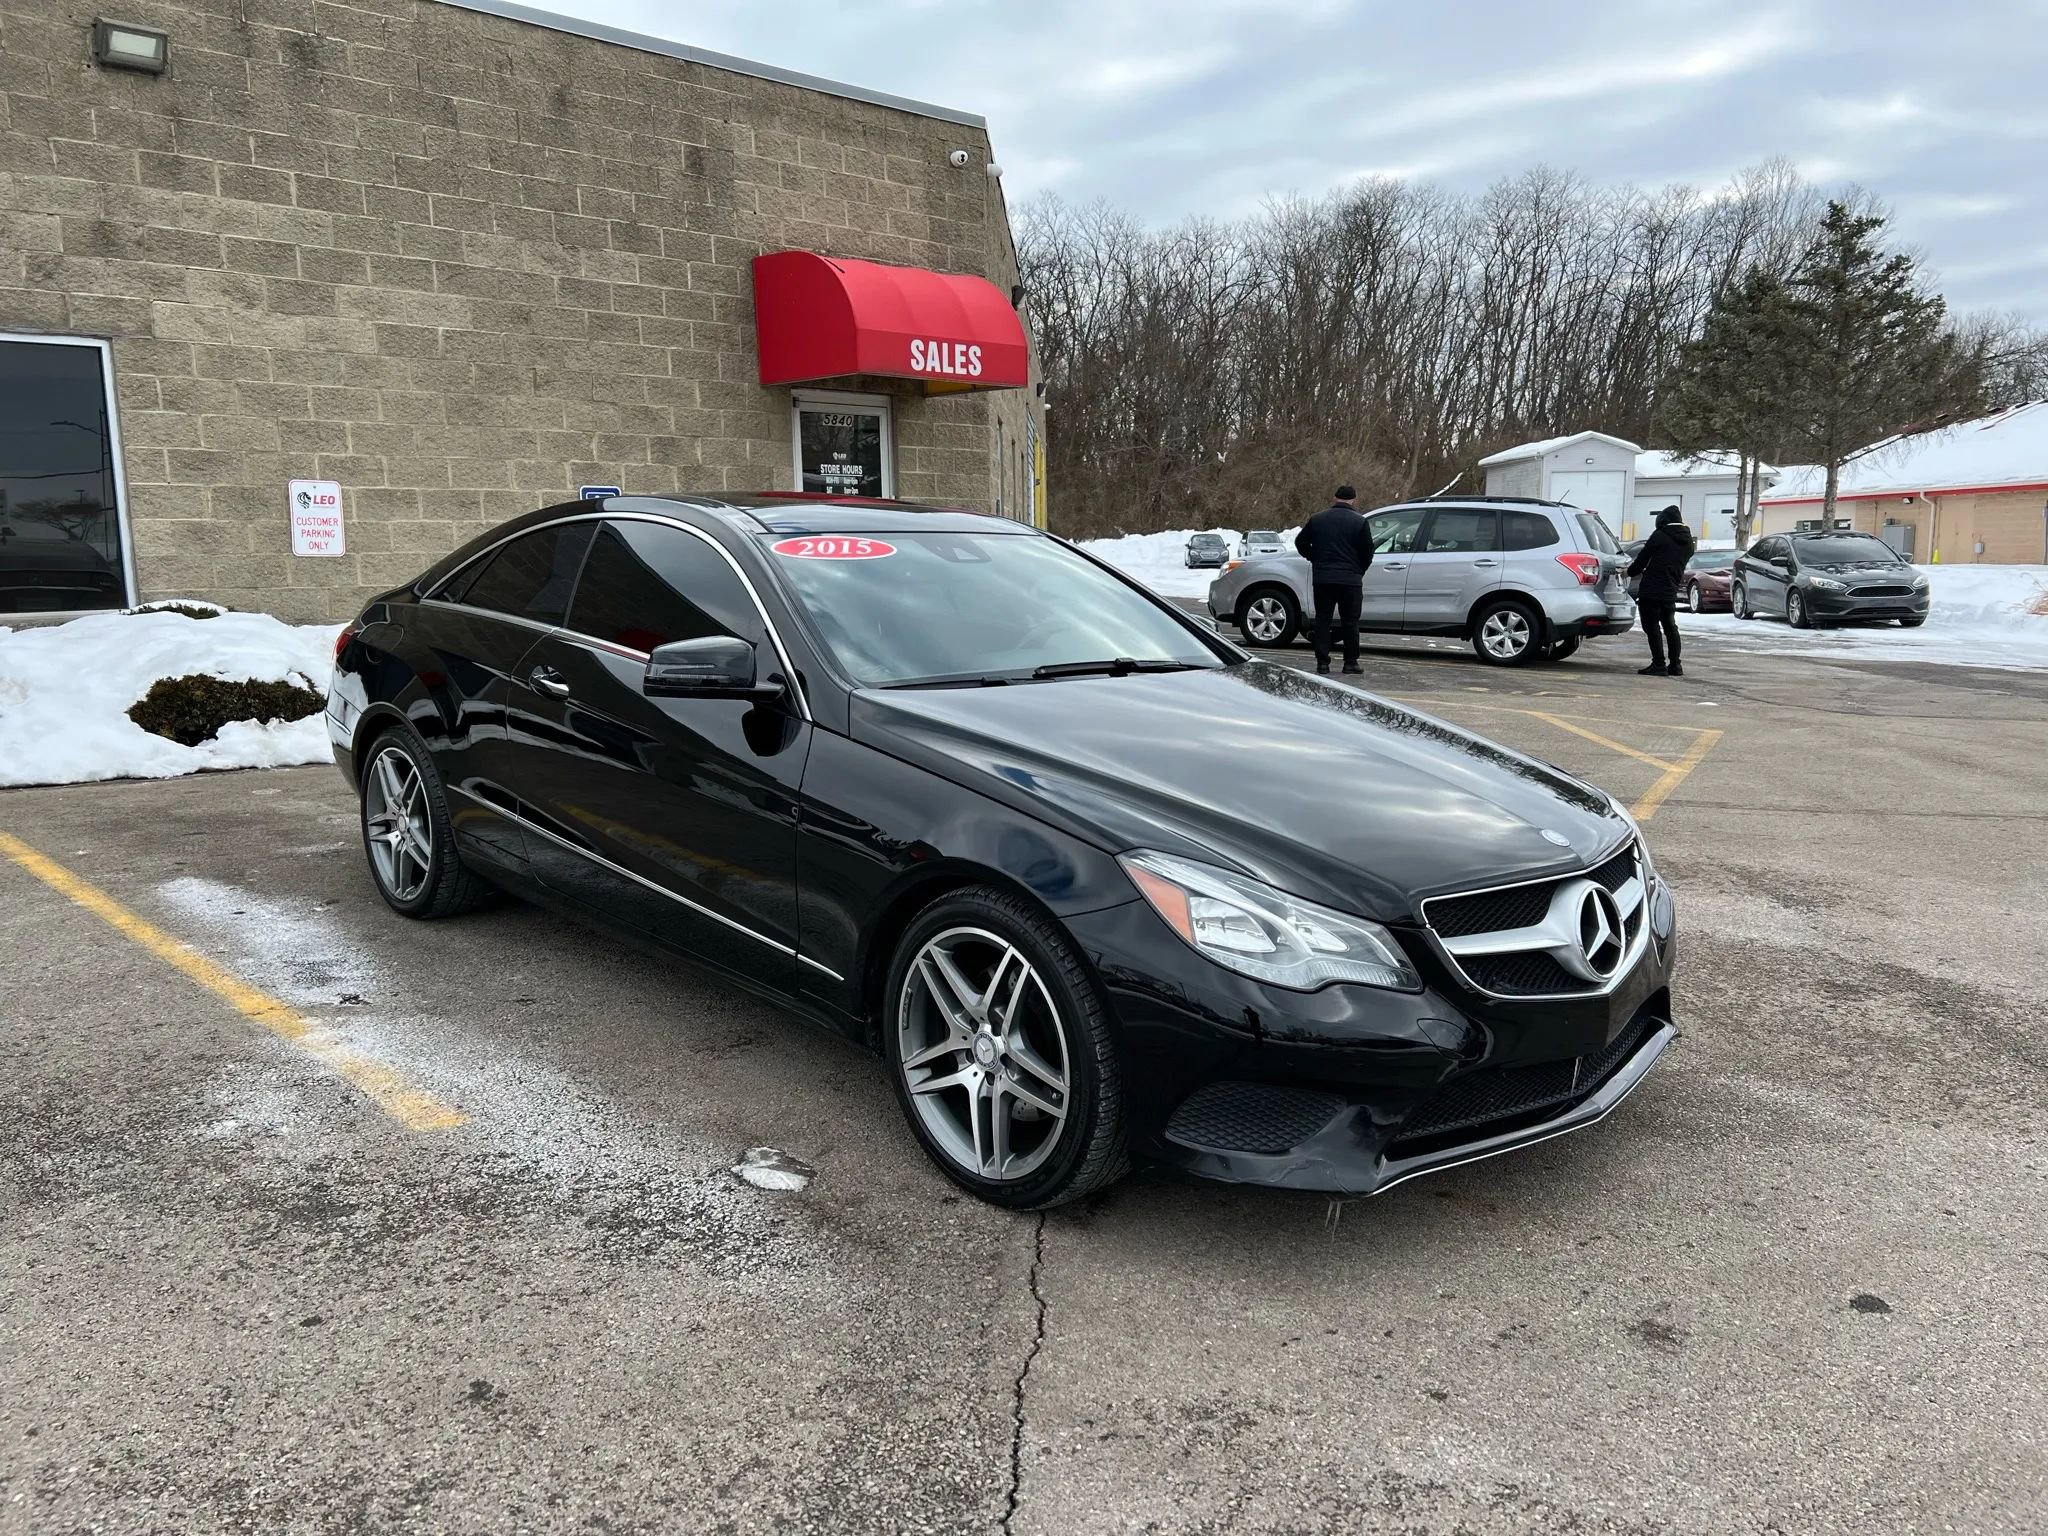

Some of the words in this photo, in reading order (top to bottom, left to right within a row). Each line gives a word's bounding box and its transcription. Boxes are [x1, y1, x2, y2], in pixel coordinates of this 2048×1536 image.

[910, 339, 982, 376] SALES
[823, 415, 853, 426] 5840
[820, 464, 840, 474] STORE
[842, 465, 863, 475] HOURS
[313, 495, 335, 505] LEO
[296, 517, 339, 527] CUSTOMER
[301, 529, 336, 538] PARKING
[308, 541, 329, 550] ONLY
[798, 540, 872, 556] 2015
